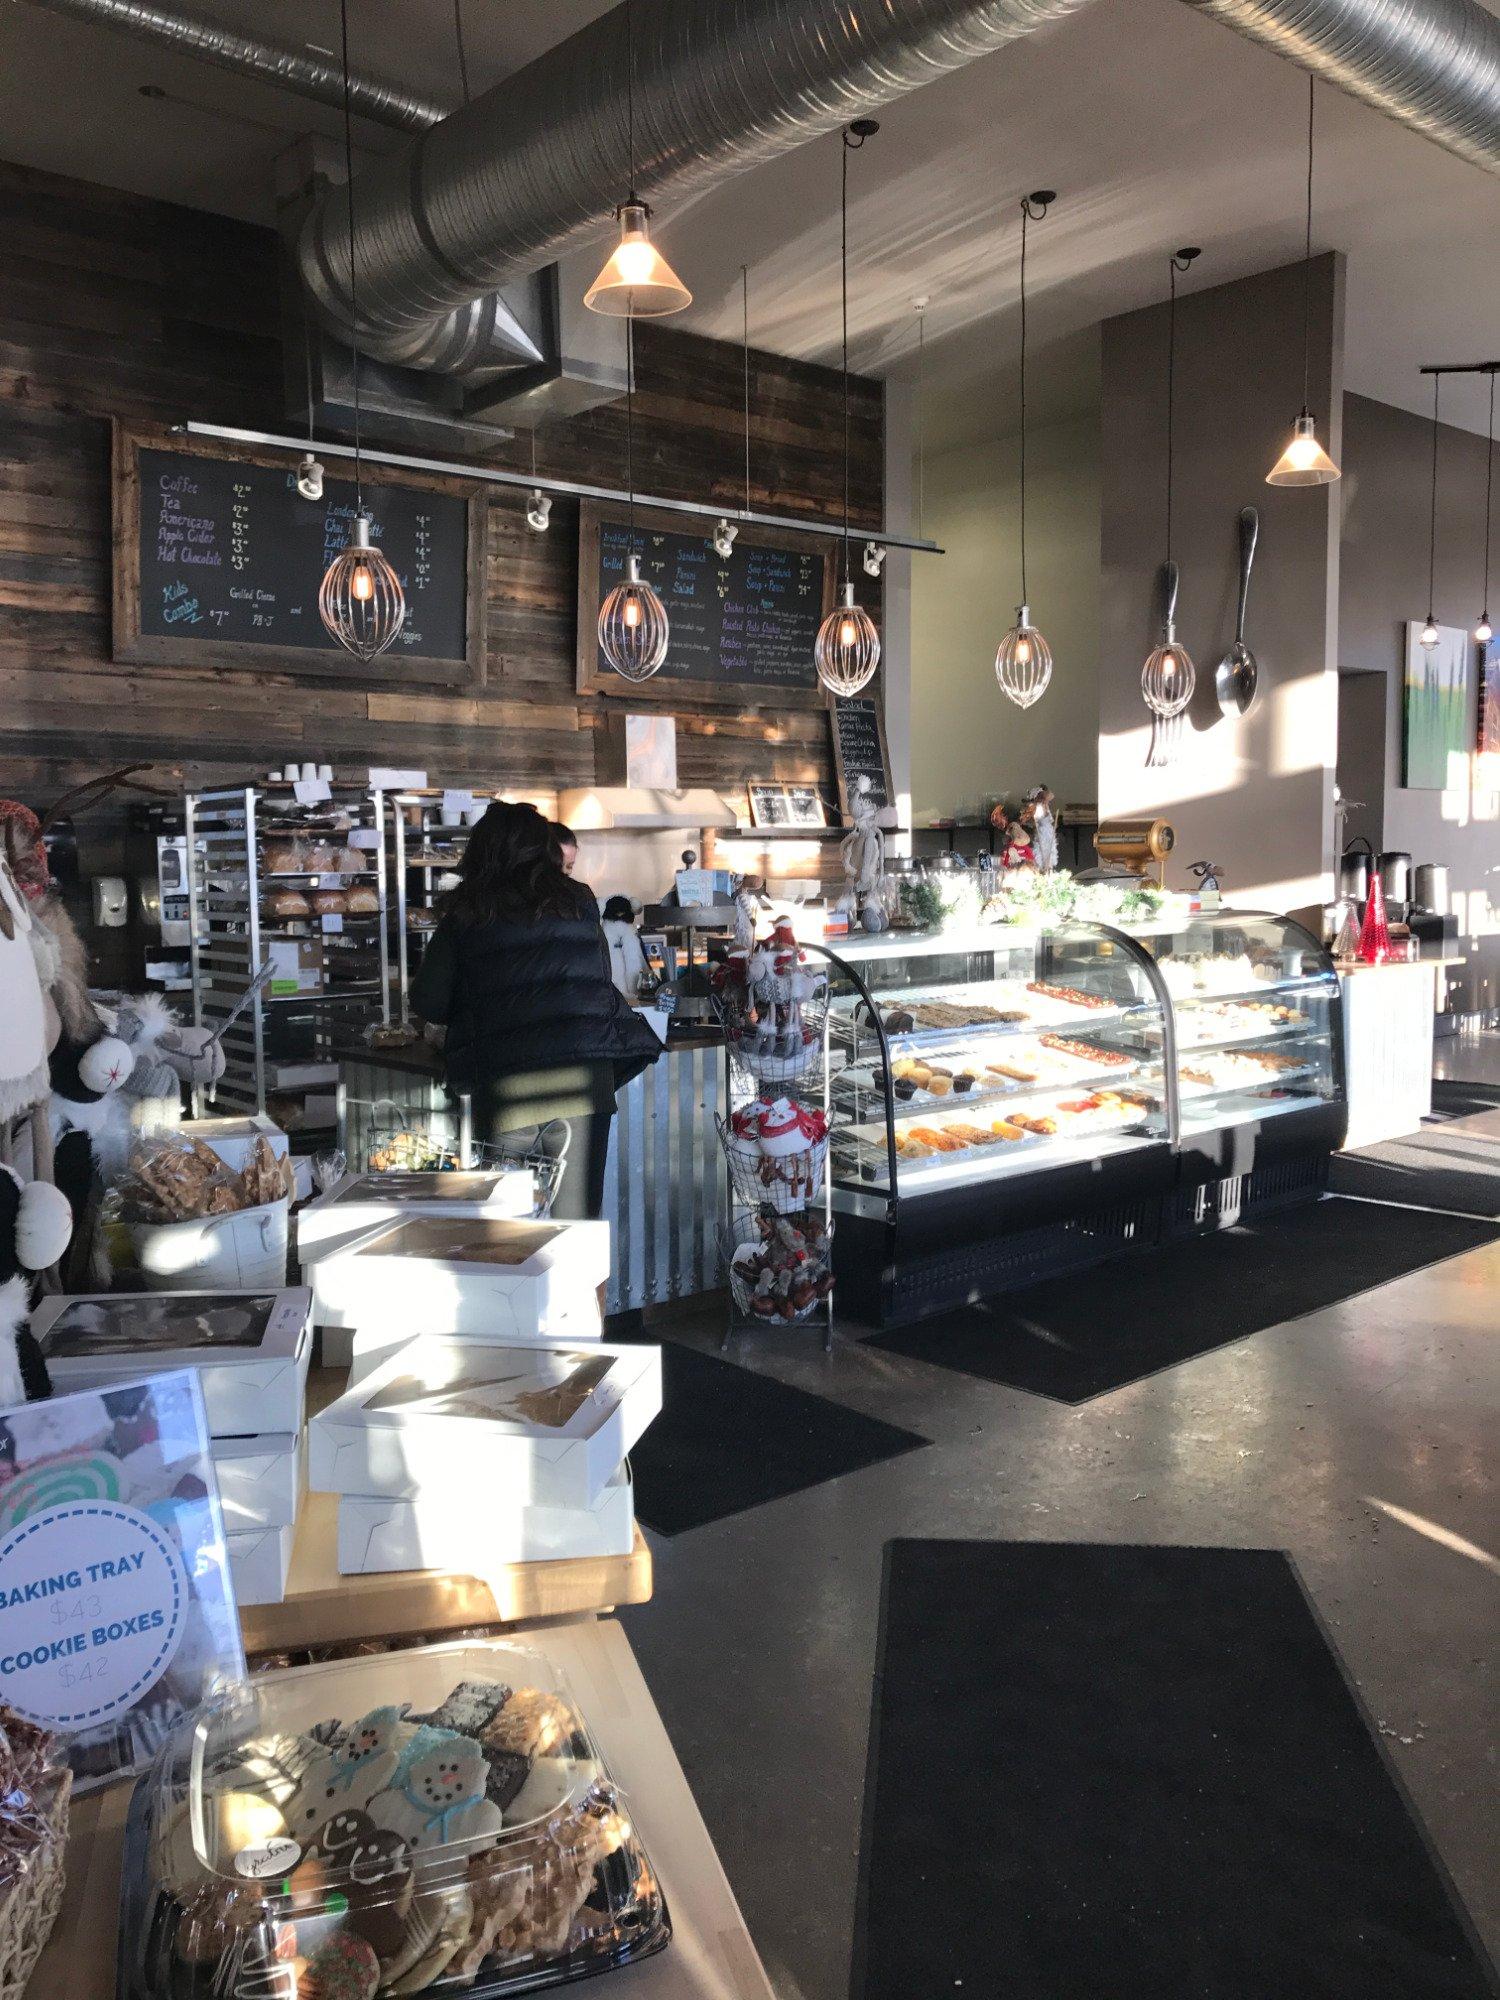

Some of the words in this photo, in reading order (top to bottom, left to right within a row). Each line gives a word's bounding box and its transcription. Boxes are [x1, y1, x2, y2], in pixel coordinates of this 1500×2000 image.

[159, 475, 200, 494] Coffee
[160, 493, 181, 510] Tea
[159, 509, 215, 531] Americano
[158, 526, 184, 545] Apple
[187, 529, 216, 544] Cider
[157, 546, 178, 562] Hot
[181, 547, 222, 566] Chocolate
[163, 599, 199, 623] Combo
[839, 700, 864, 711] Salad
[85, 1551, 145, 1583] TRAY
[50, 1594, 103, 1627] $43
[0, 1633, 88, 1676] COOKIE
[91, 1609, 165, 1647] BOXES
[57, 1656, 110, 1689] $42
